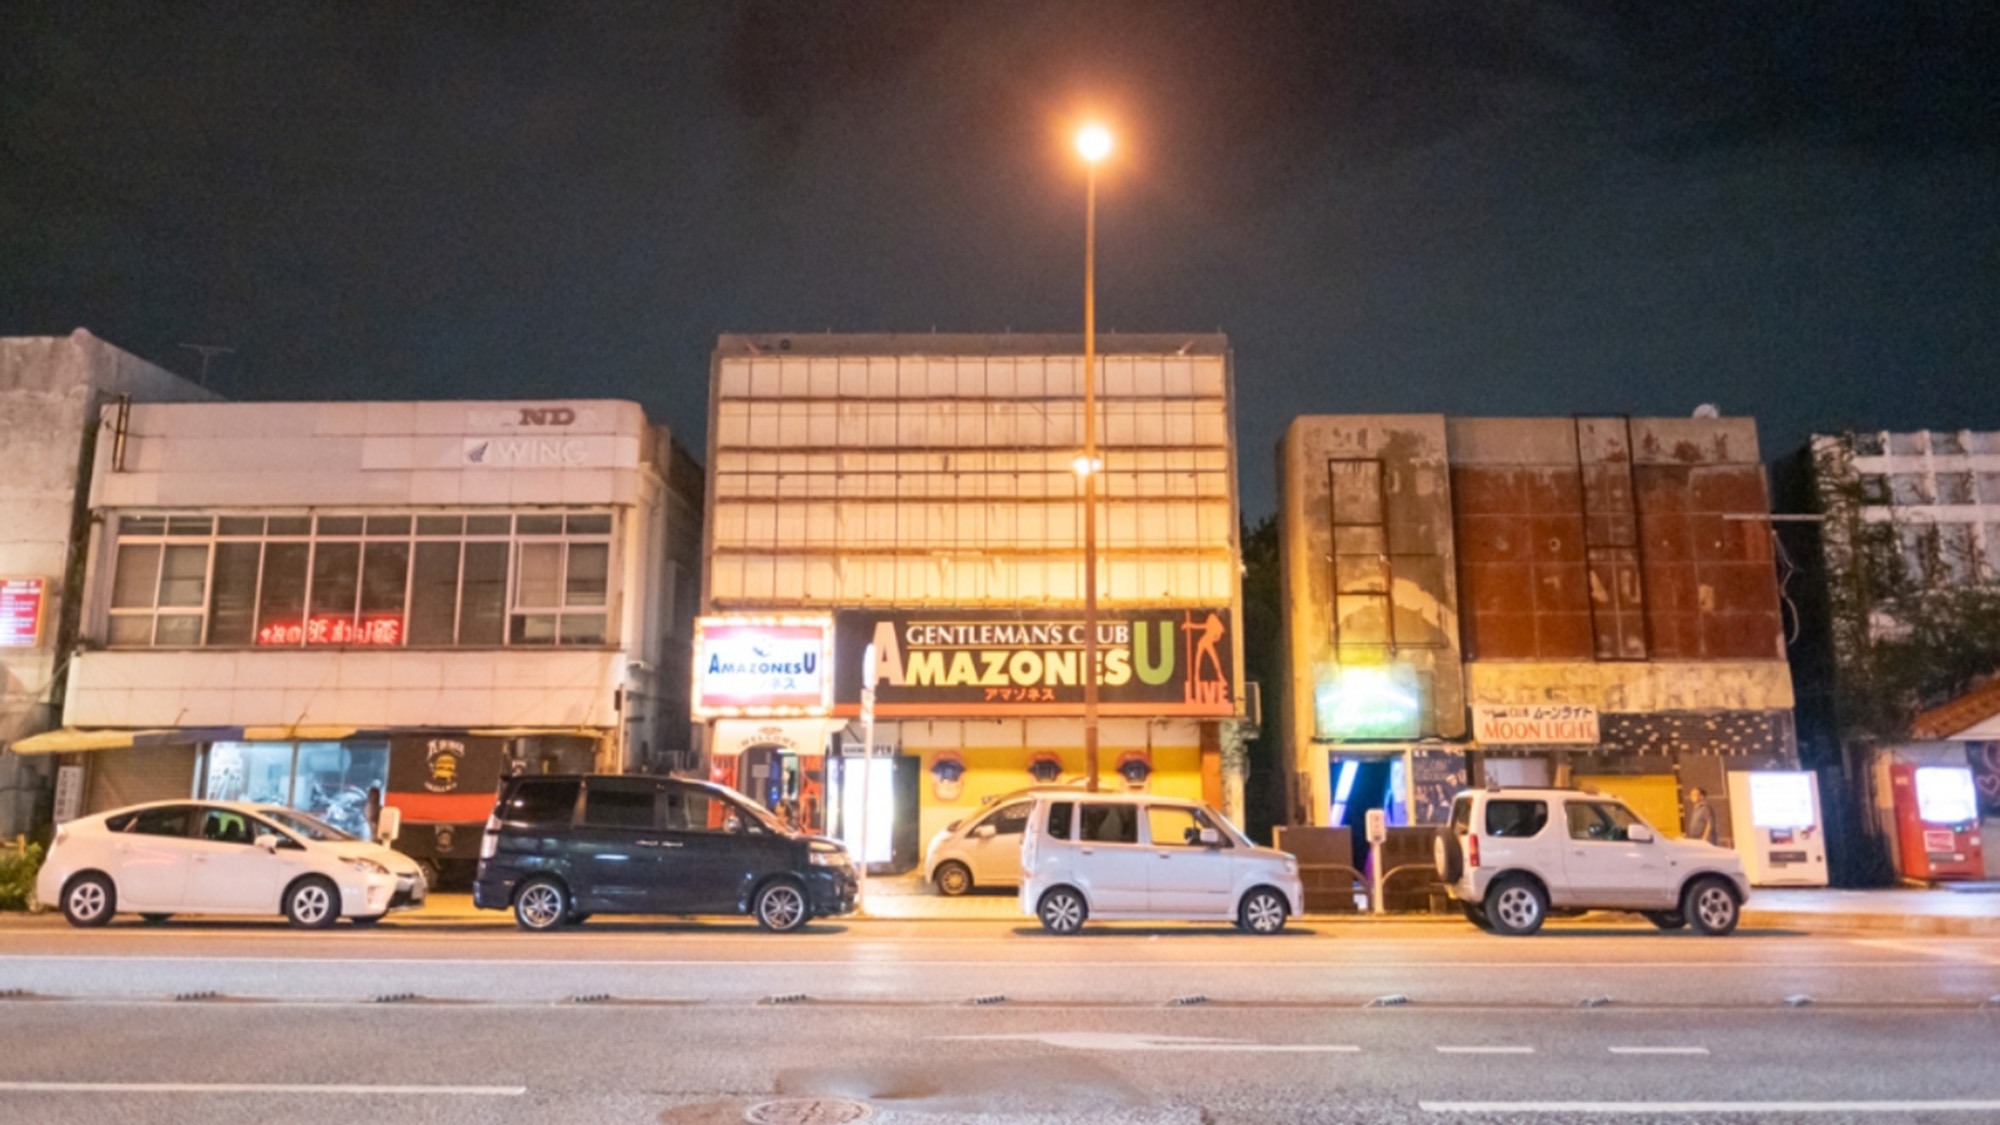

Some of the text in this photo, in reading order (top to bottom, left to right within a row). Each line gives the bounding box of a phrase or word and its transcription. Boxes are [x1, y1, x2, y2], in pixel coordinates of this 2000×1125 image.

[498, 439, 588, 464] WING
[906, 625, 1129, 644] GENTLEMAN'S CUB
[984, 687, 1056, 702] アマゾネス
[1533, 706, 1593, 720] ムーンライト
[1484, 722, 1541, 740] MOON
